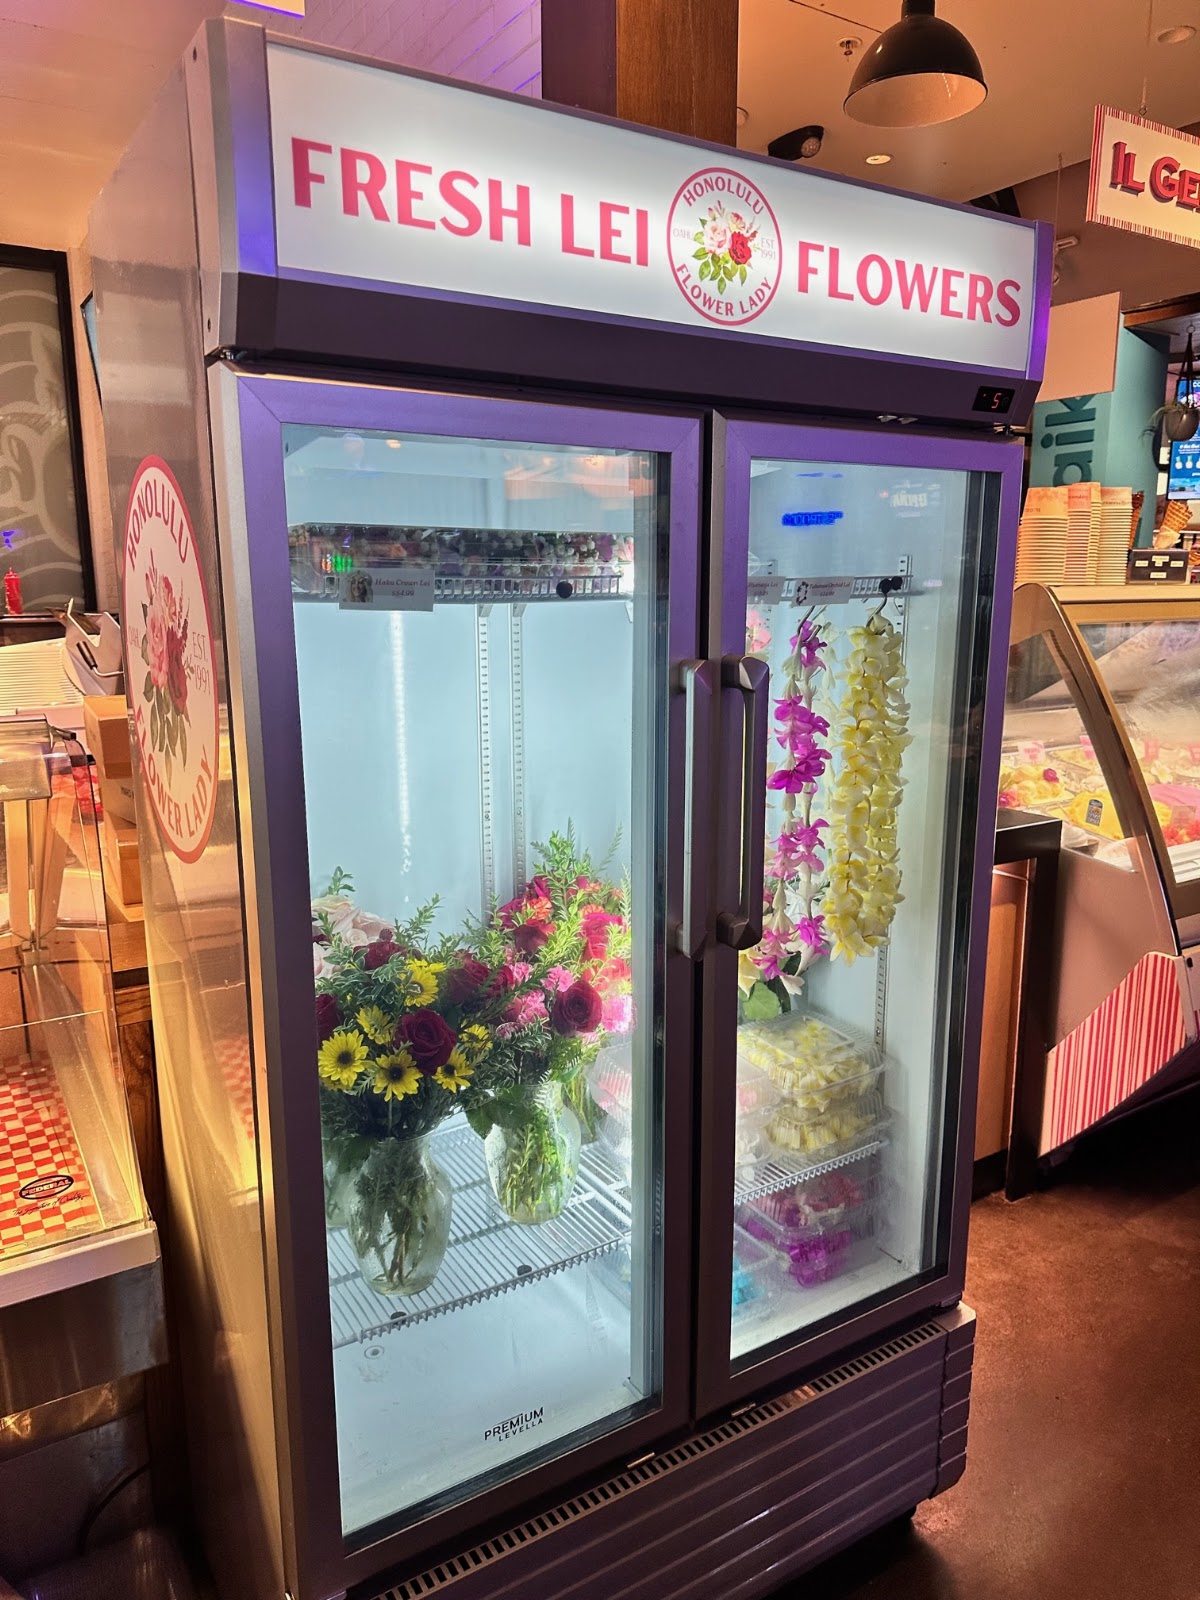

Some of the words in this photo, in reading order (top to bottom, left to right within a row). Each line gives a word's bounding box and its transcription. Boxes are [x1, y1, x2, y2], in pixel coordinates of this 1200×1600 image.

[1111, 141, 1146, 193] IL
[682, 176, 764, 215] HONOLULU
[291, 137, 531, 247] FRESH
[560, 193, 649, 267] LEI
[797, 240, 1021, 327] FLOWERS
[676, 263, 734, 317] FLOWER
[739, 277, 772, 315] LADY
[127, 478, 189, 571] HONOLULU
[194, 664, 211, 695] 1991
[136, 705, 183, 839] FLOWER
[184, 744, 213, 839] LADY
[484, 1406, 544, 1441] PREMIUM
[498, 1417, 543, 1442] LEVELLA
